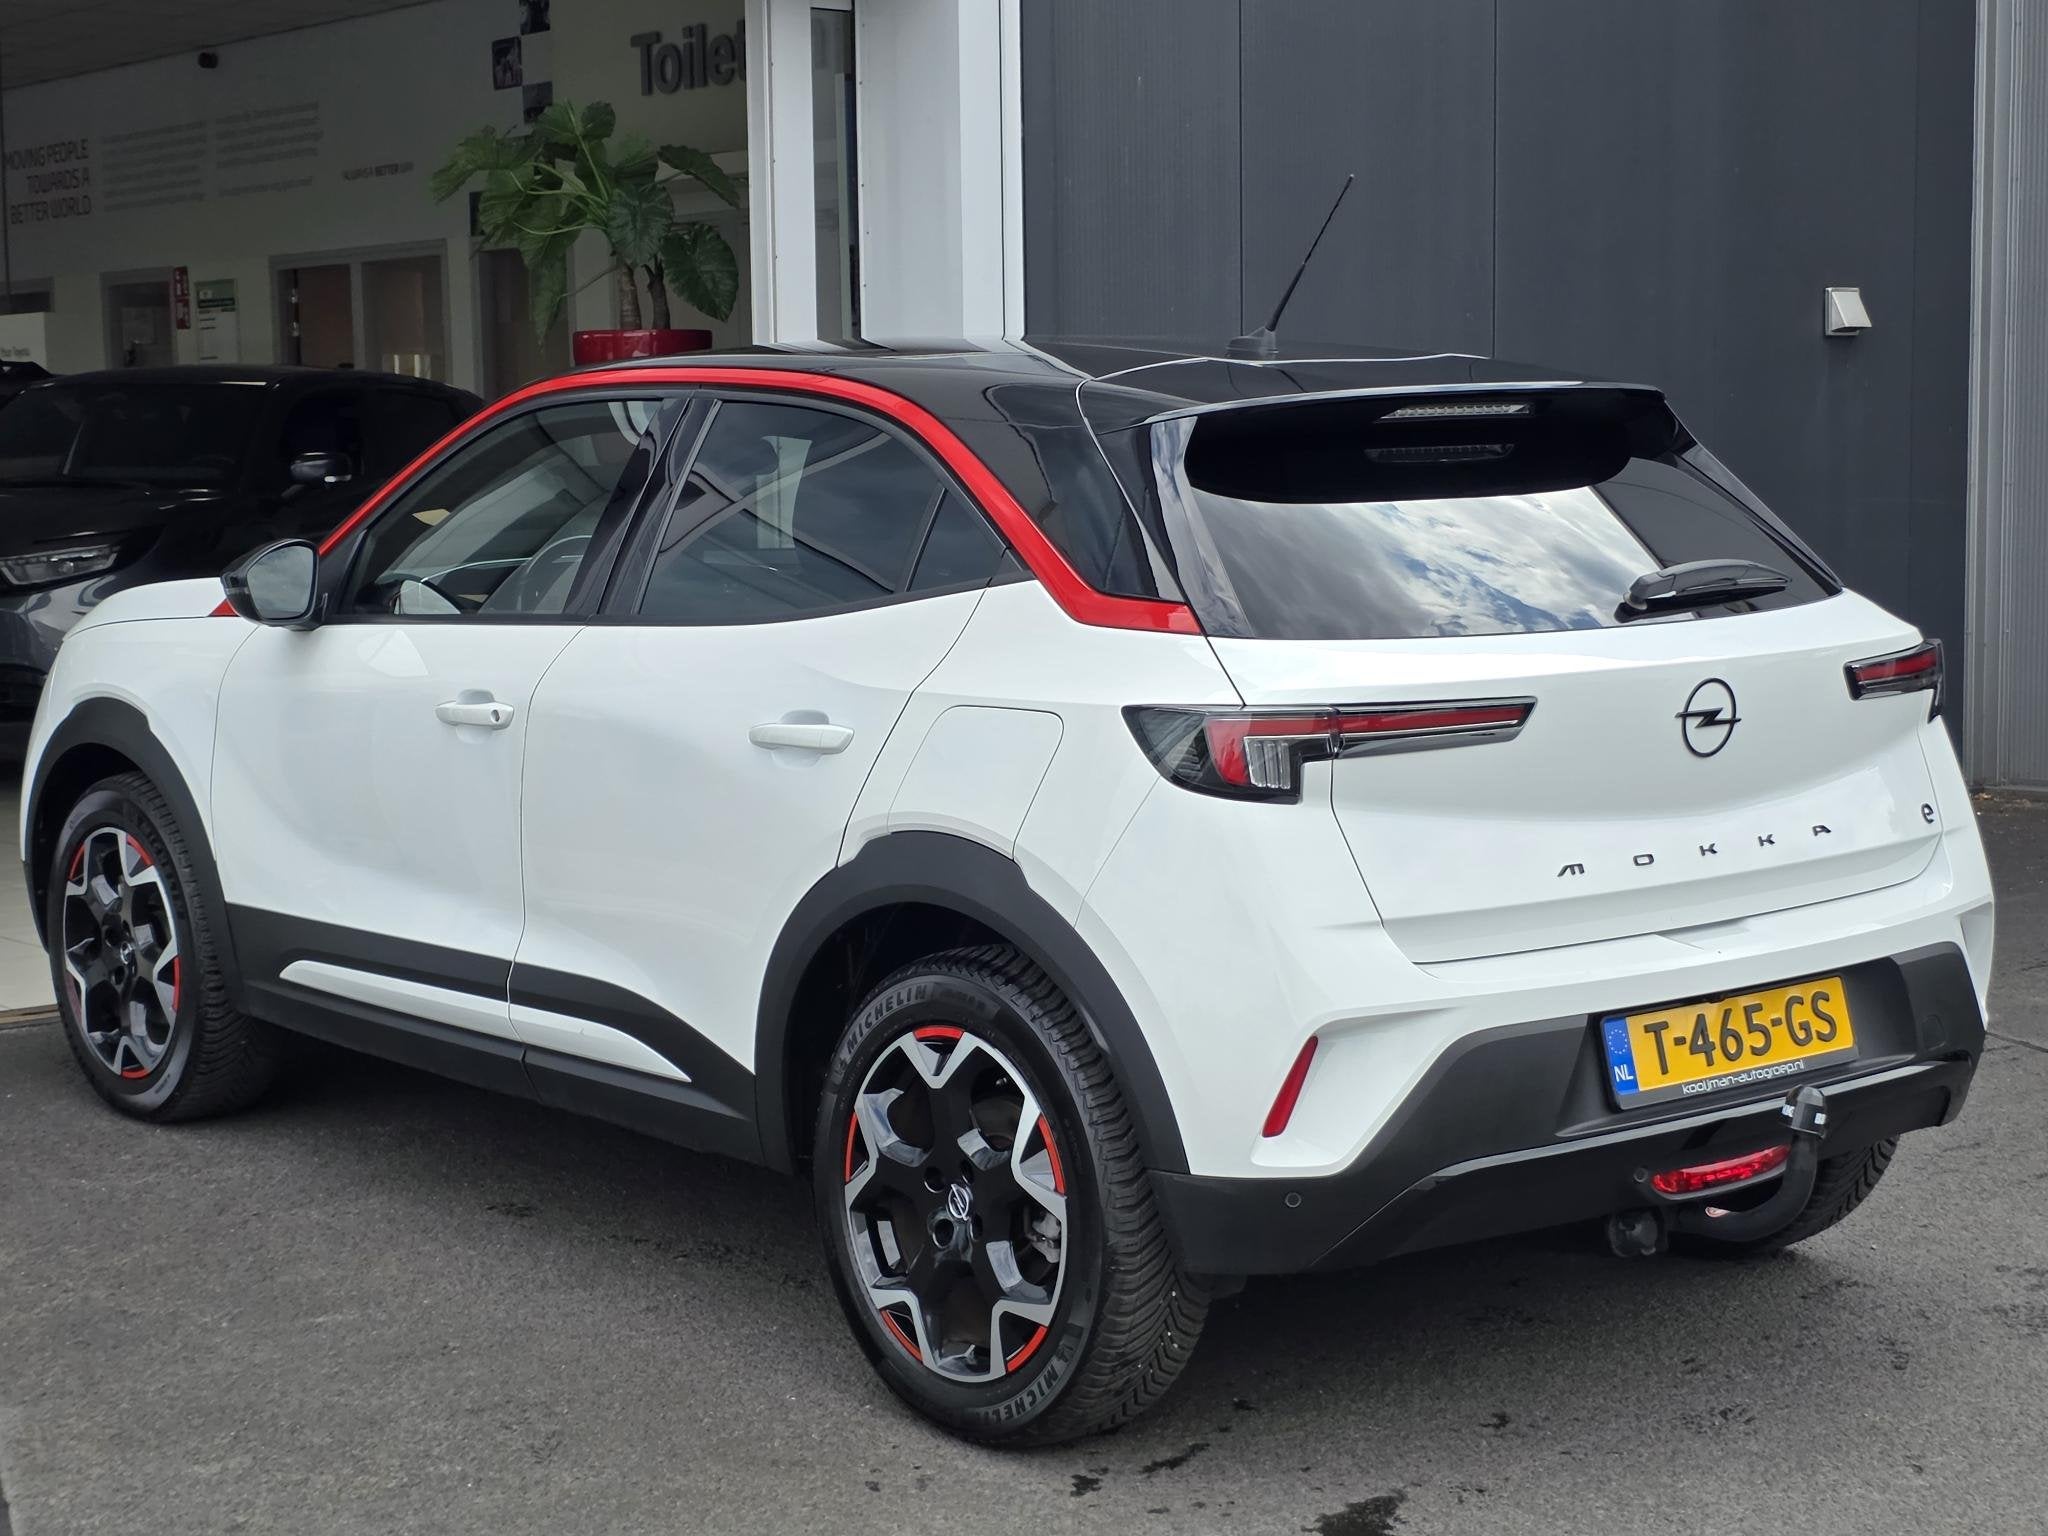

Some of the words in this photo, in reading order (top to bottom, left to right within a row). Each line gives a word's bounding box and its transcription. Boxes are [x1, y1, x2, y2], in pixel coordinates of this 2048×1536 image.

[47, 139, 89, 163] PEOPLE
[27, 170, 80, 194] TOWARDS
[81, 167, 90, 188] A
[11, 201, 49, 224] BETTER
[50, 195, 91, 219] WORLD
[1921, 803, 1935, 825] e
[1557, 824, 1832, 878] MOKKA
[846, 984, 928, 1055] MICHELIN
[1644, 991, 1837, 1075] T-465-GS
[1614, 1064, 1634, 1083] NL
[1682, 1060, 1804, 1095] kooijman-autogroep.nl
